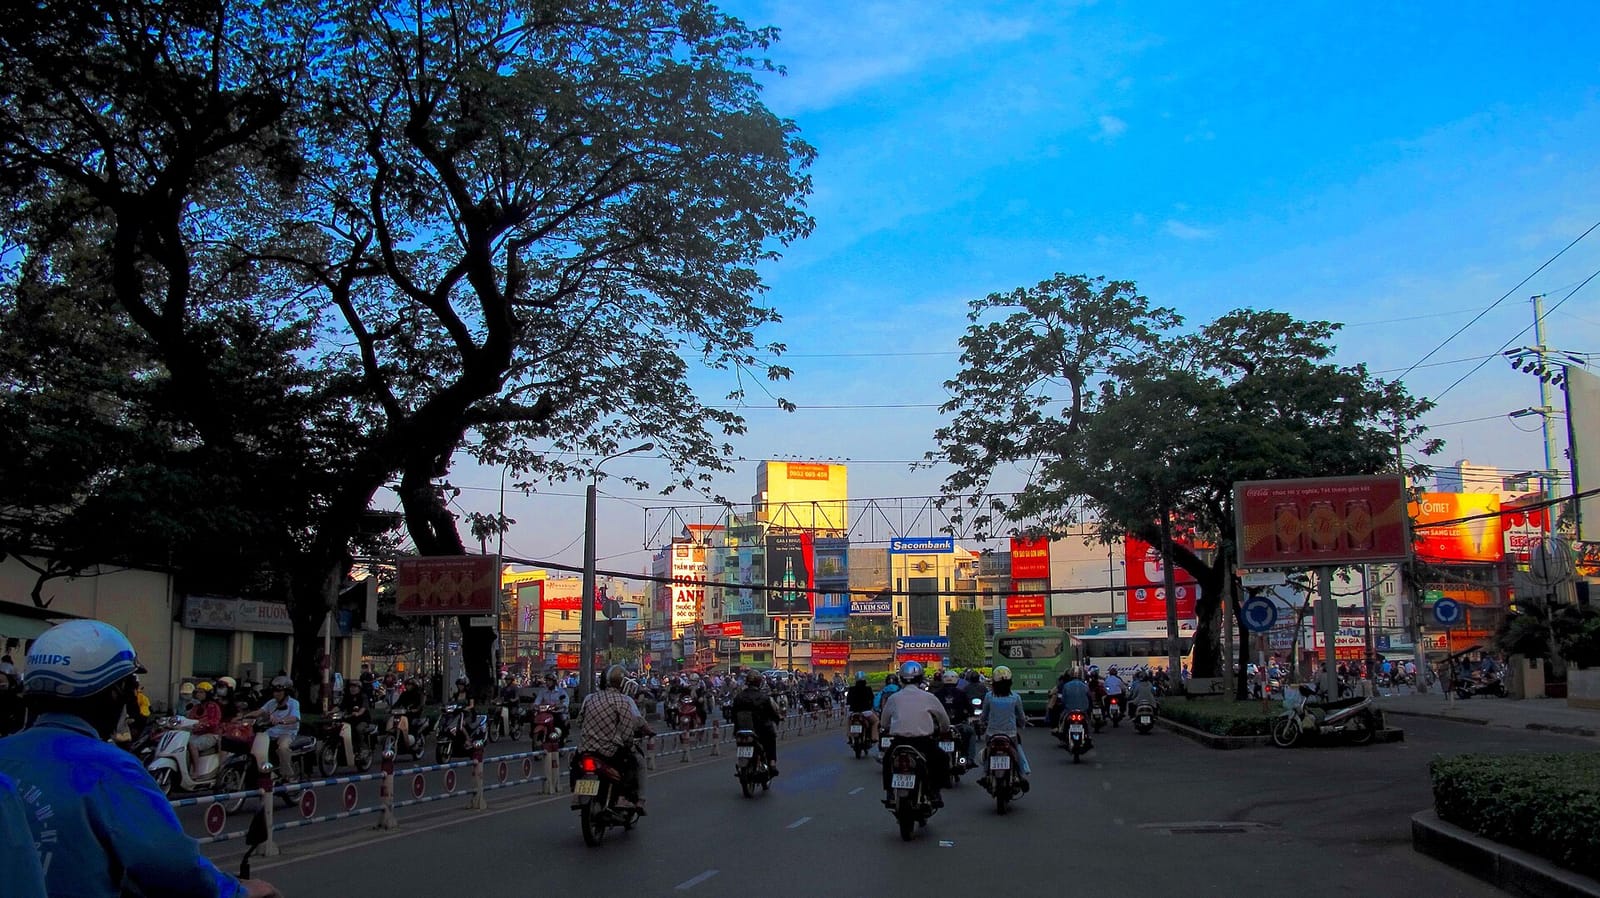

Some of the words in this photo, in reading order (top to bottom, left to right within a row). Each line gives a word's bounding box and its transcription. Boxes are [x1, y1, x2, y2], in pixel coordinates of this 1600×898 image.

[893, 540, 951, 551] Sacombank
[677, 590, 705, 602] ANH
[1011, 647, 1022, 657] 35
[27, 654, 71, 666] PHILIPS
